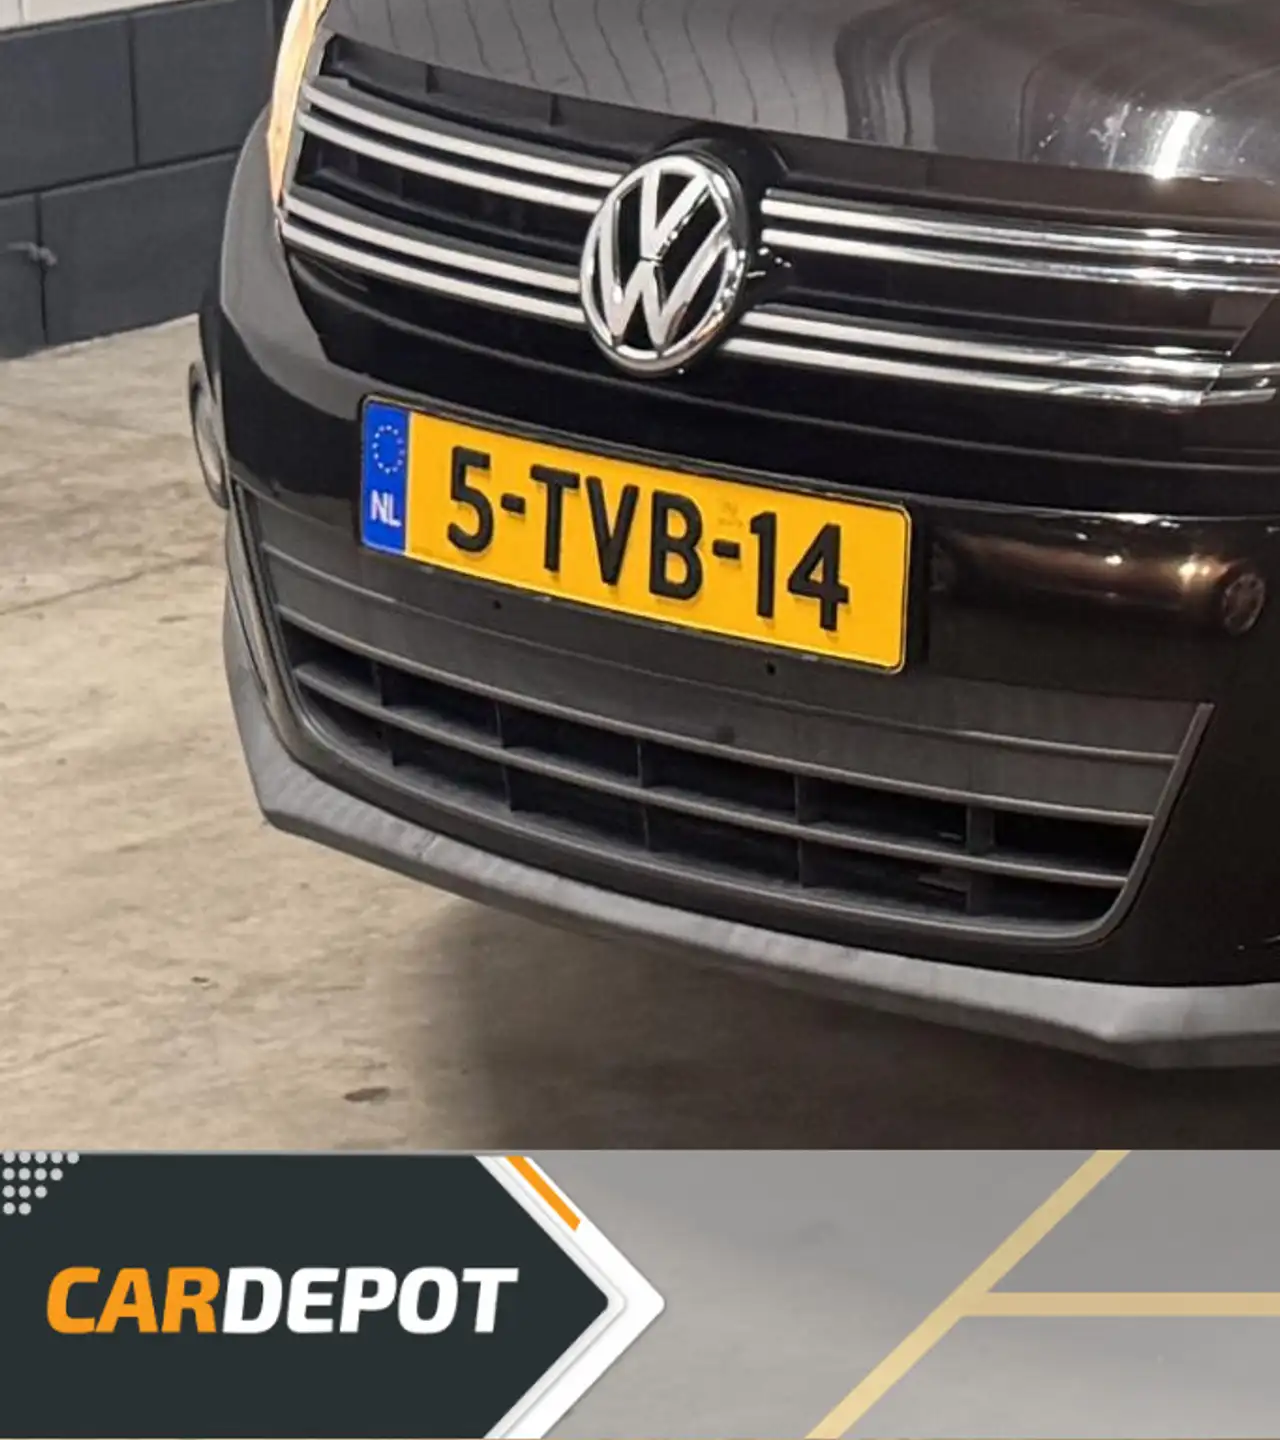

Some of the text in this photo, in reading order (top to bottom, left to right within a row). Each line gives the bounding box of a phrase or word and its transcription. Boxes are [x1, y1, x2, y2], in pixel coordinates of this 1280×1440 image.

[588, 157, 736, 358] VW
[369, 490, 402, 527] NL
[447, 445, 850, 632] 5-TVB-14
